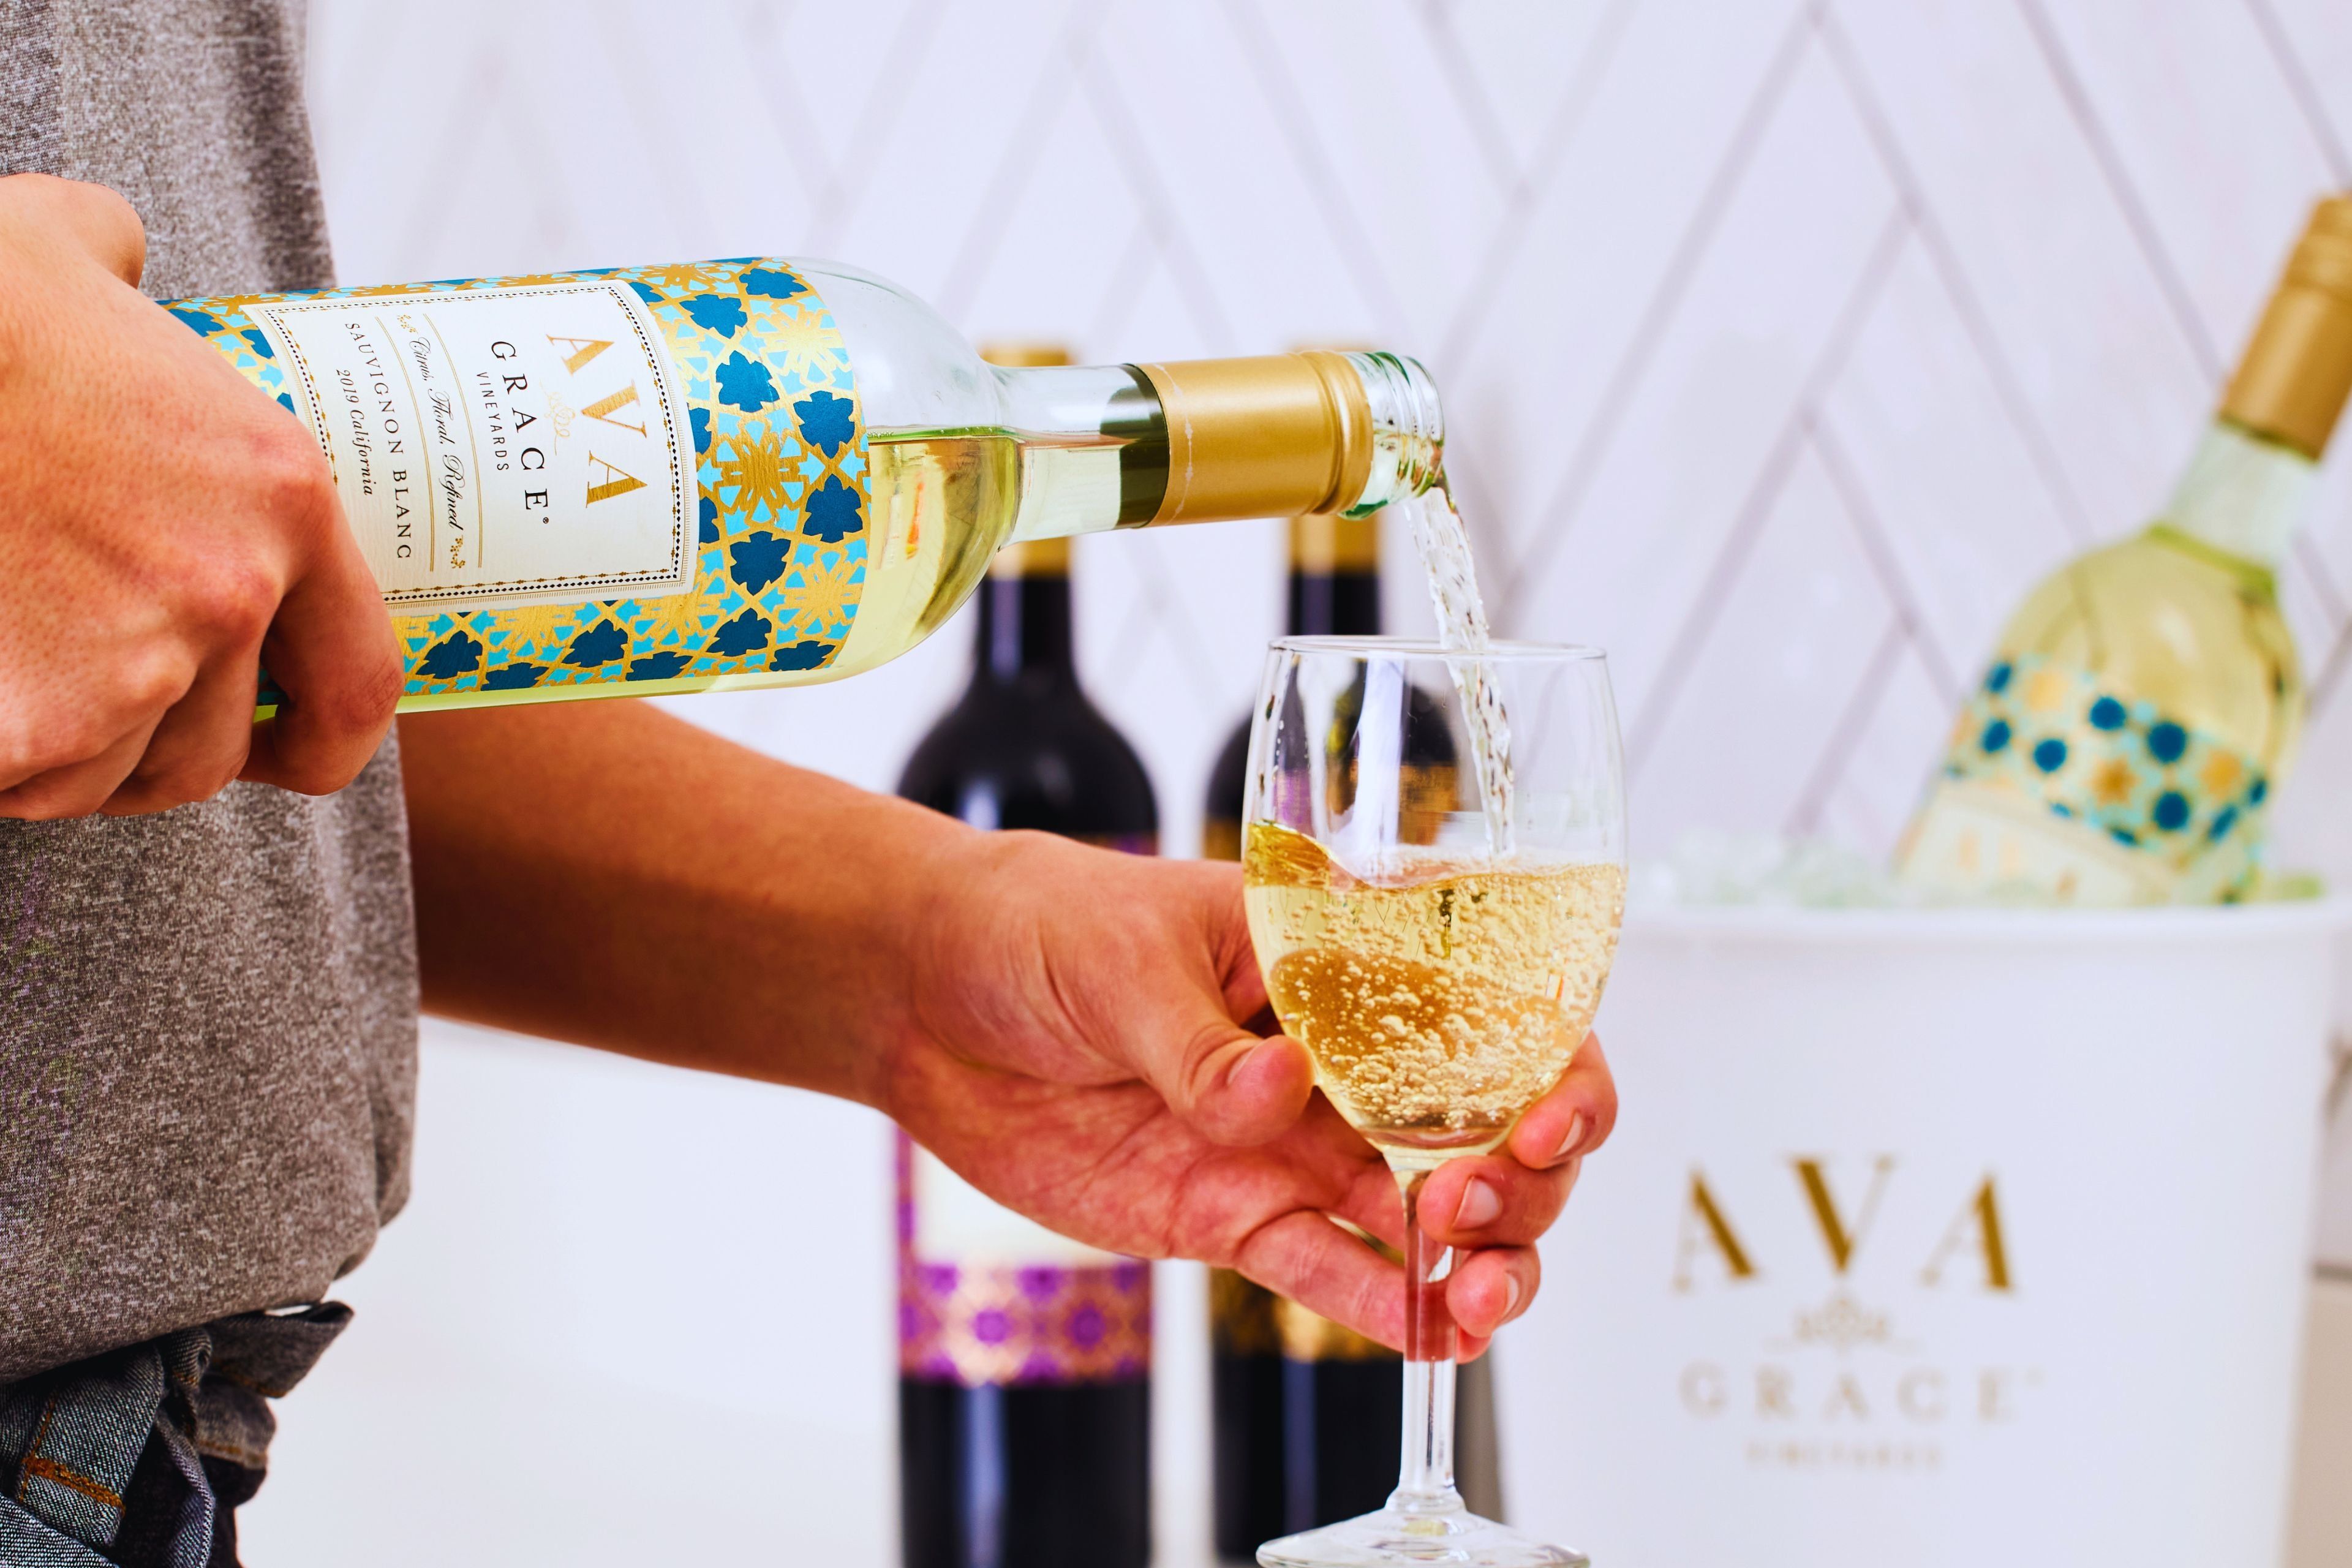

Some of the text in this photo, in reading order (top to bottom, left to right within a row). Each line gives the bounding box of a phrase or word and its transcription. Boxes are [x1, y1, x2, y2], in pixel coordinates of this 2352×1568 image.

[336, 369, 377, 495] 2019 California
[345, 323, 412, 559] SAUVIGNON BLANC
[409, 337, 466, 530] Citrus, Floral, Refined
[477, 371, 510, 471] VINEYARDS
[546, 334, 647, 508] AVA
[1670, 1154, 2020, 1294] AVA
